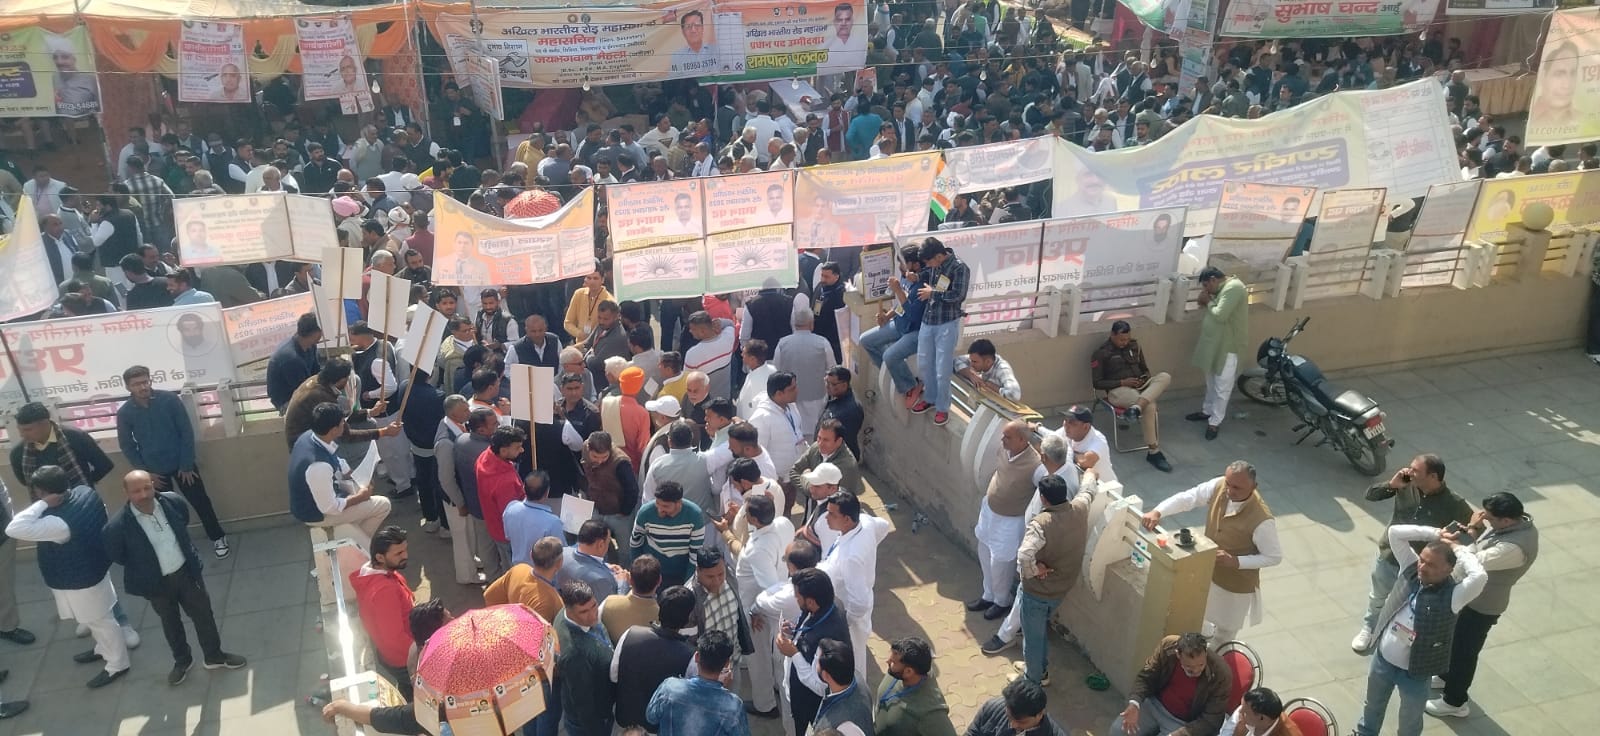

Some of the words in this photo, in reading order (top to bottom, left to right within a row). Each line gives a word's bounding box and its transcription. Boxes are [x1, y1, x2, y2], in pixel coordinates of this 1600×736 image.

[1274, 2, 1331, 24] सुभाष
[501, 26, 538, 36] अखिल
[540, 24, 579, 35] भारतीय
[537, 33, 596, 46] महासचिव
[746, 54, 789, 70] रामपाल
